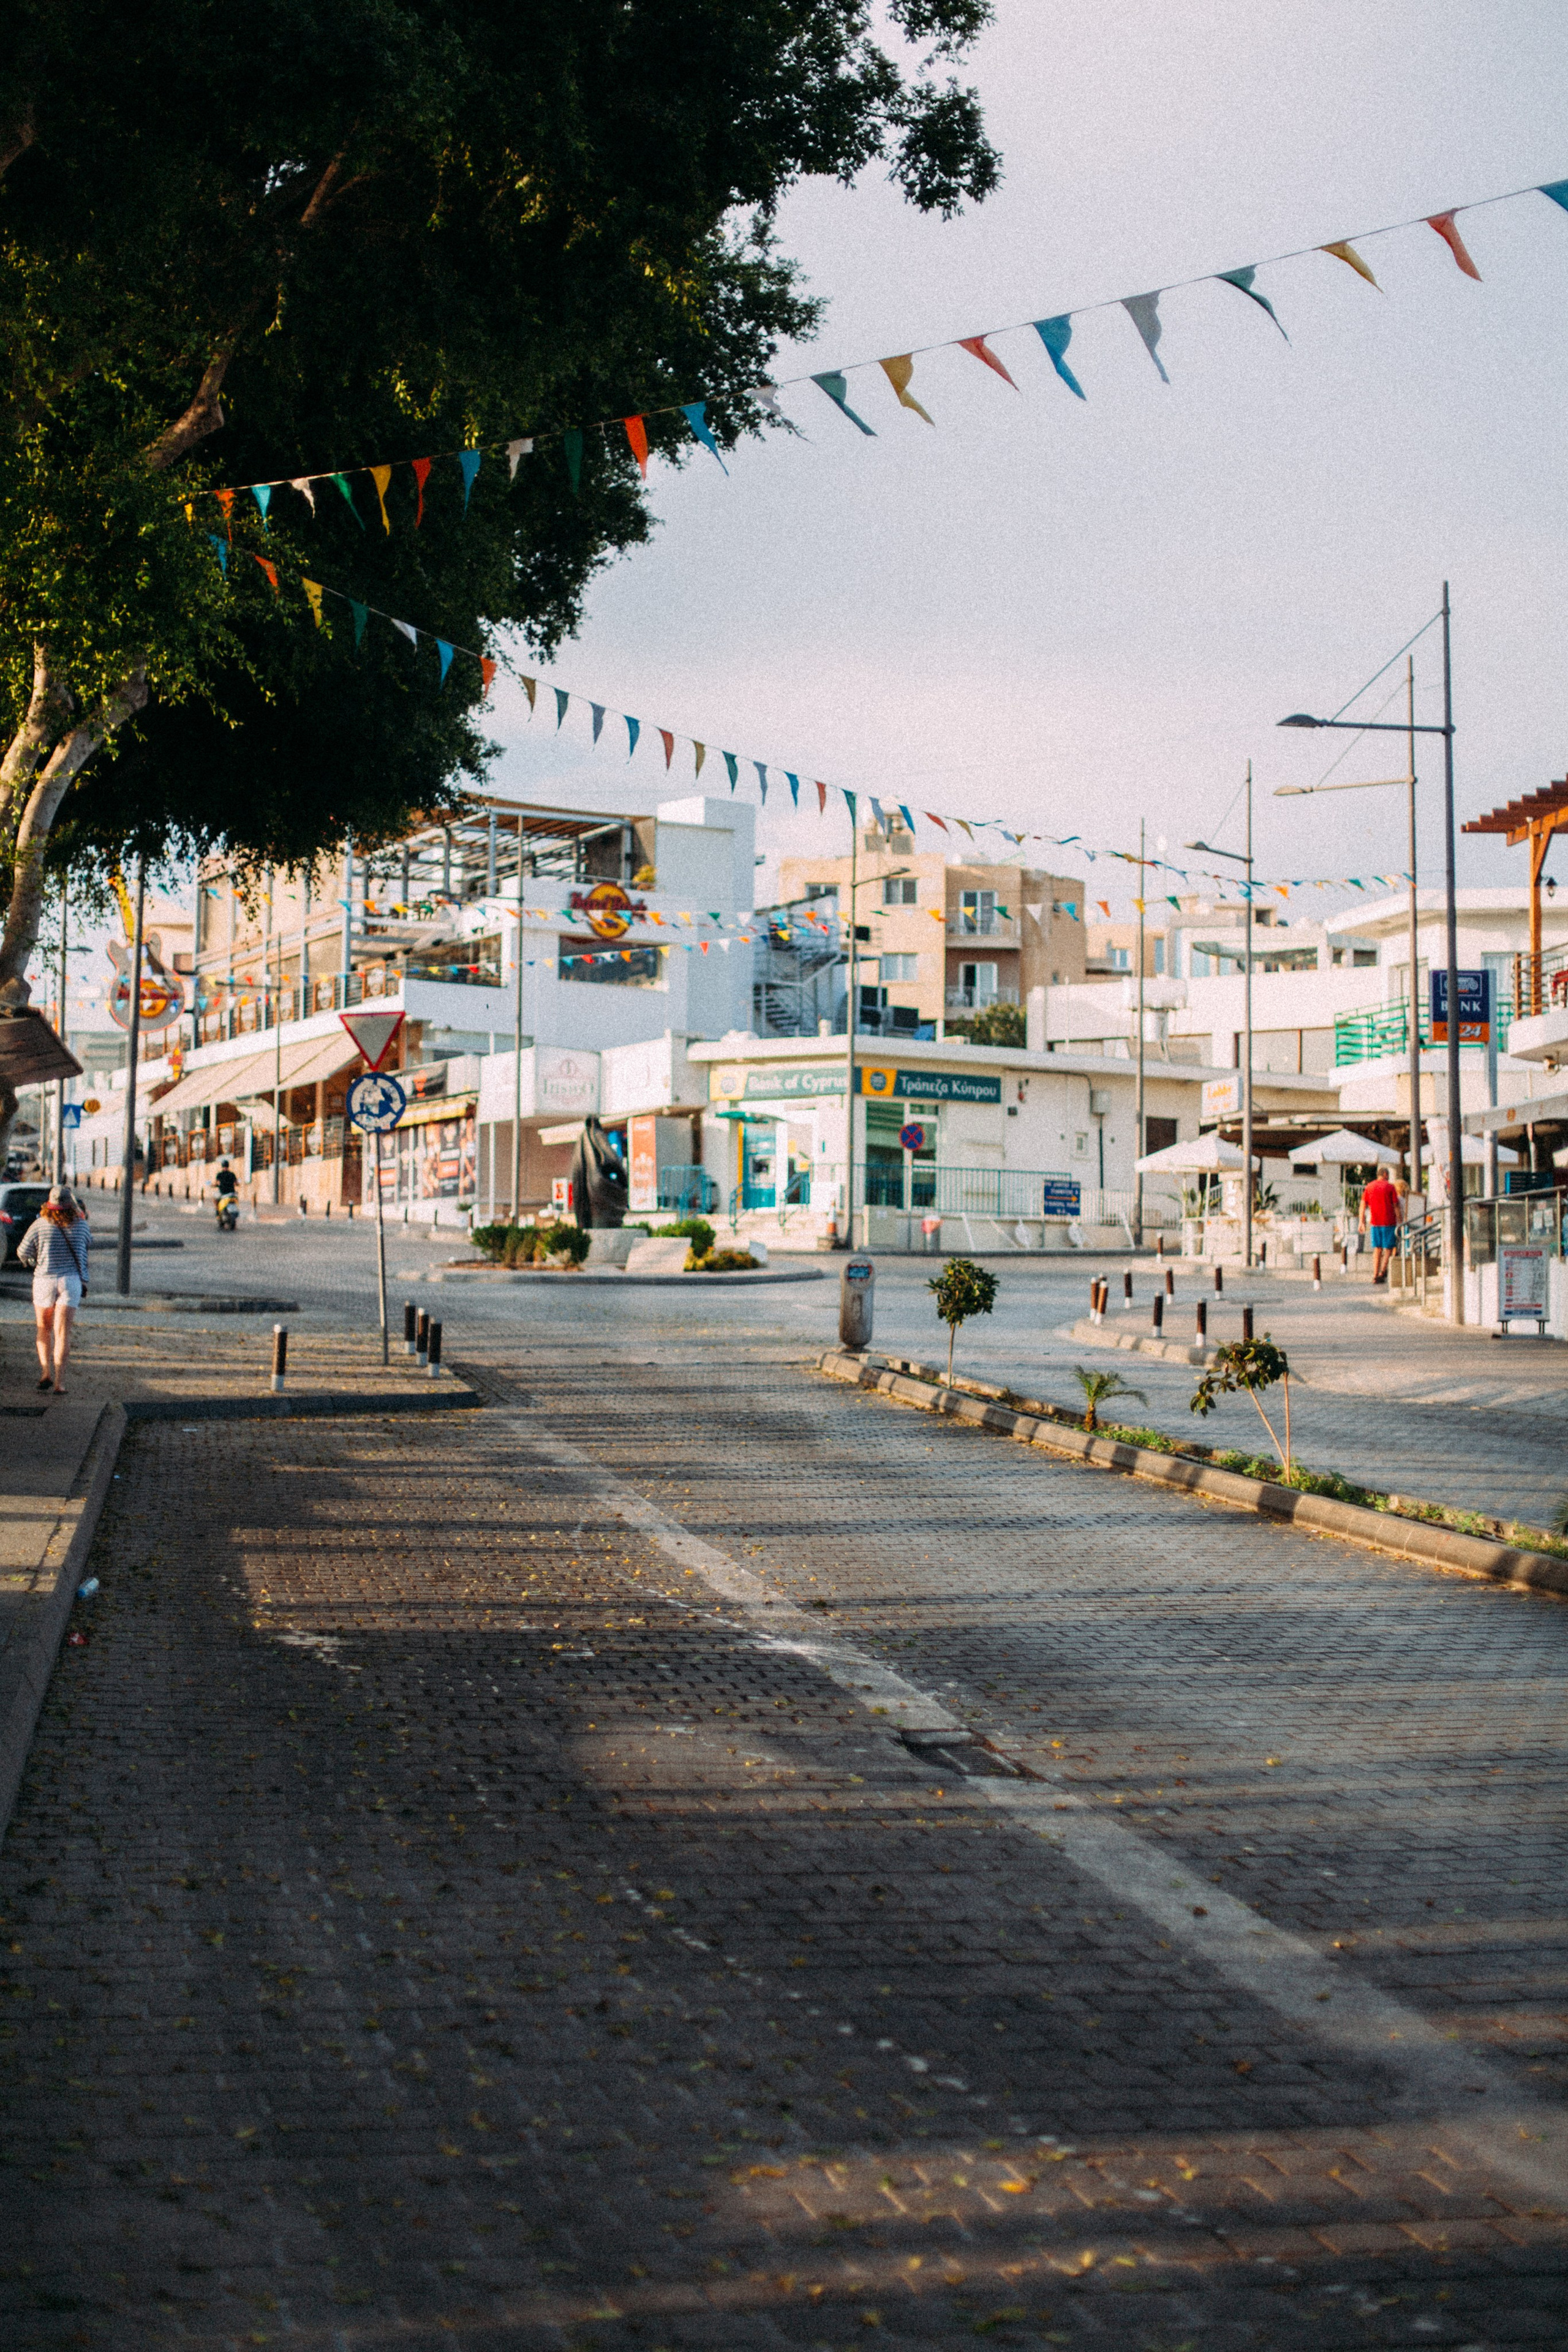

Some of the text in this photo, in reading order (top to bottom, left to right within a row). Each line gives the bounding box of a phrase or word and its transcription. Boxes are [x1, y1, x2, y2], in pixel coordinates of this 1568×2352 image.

[1441, 1000, 1481, 1012] BNK
[1460, 1025, 1482, 1038] 24
[748, 1076, 783, 1091] Bank
[785, 1074, 800, 1090] of
[900, 1076, 948, 1097] Τράπεζα
[952, 1080, 997, 1099] Κύπρου
